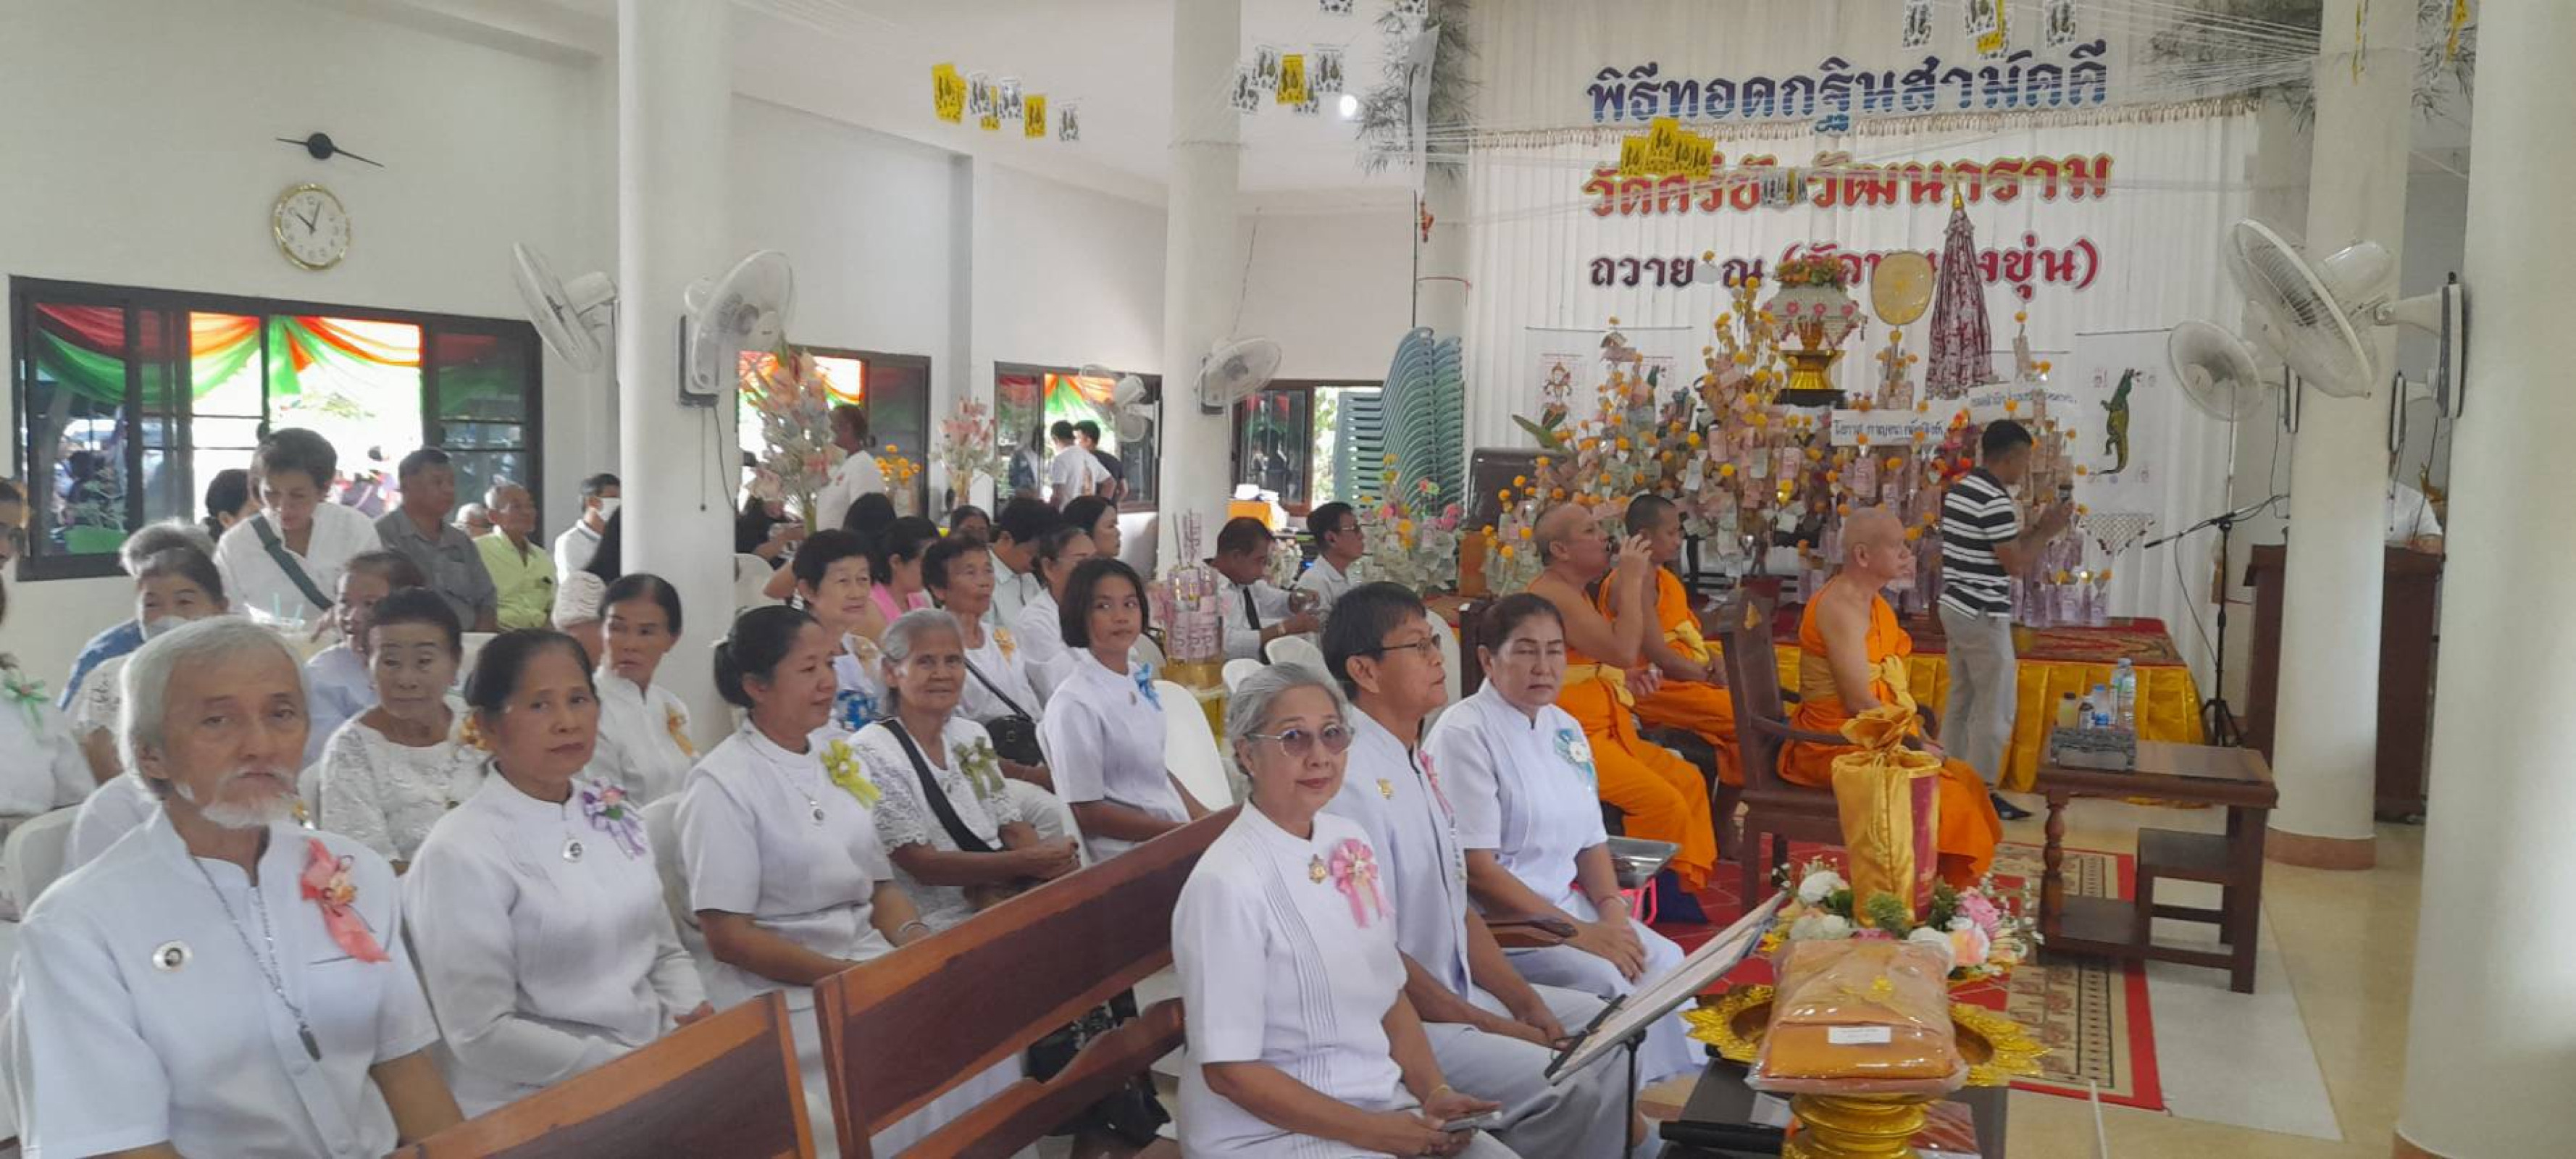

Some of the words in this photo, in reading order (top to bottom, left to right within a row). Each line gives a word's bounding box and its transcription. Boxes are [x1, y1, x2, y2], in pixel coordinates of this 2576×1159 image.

[1586, 39, 2107, 132] พิธีทอดกฐินสามัคคี
[1590, 256, 1695, 287] ถวาย
